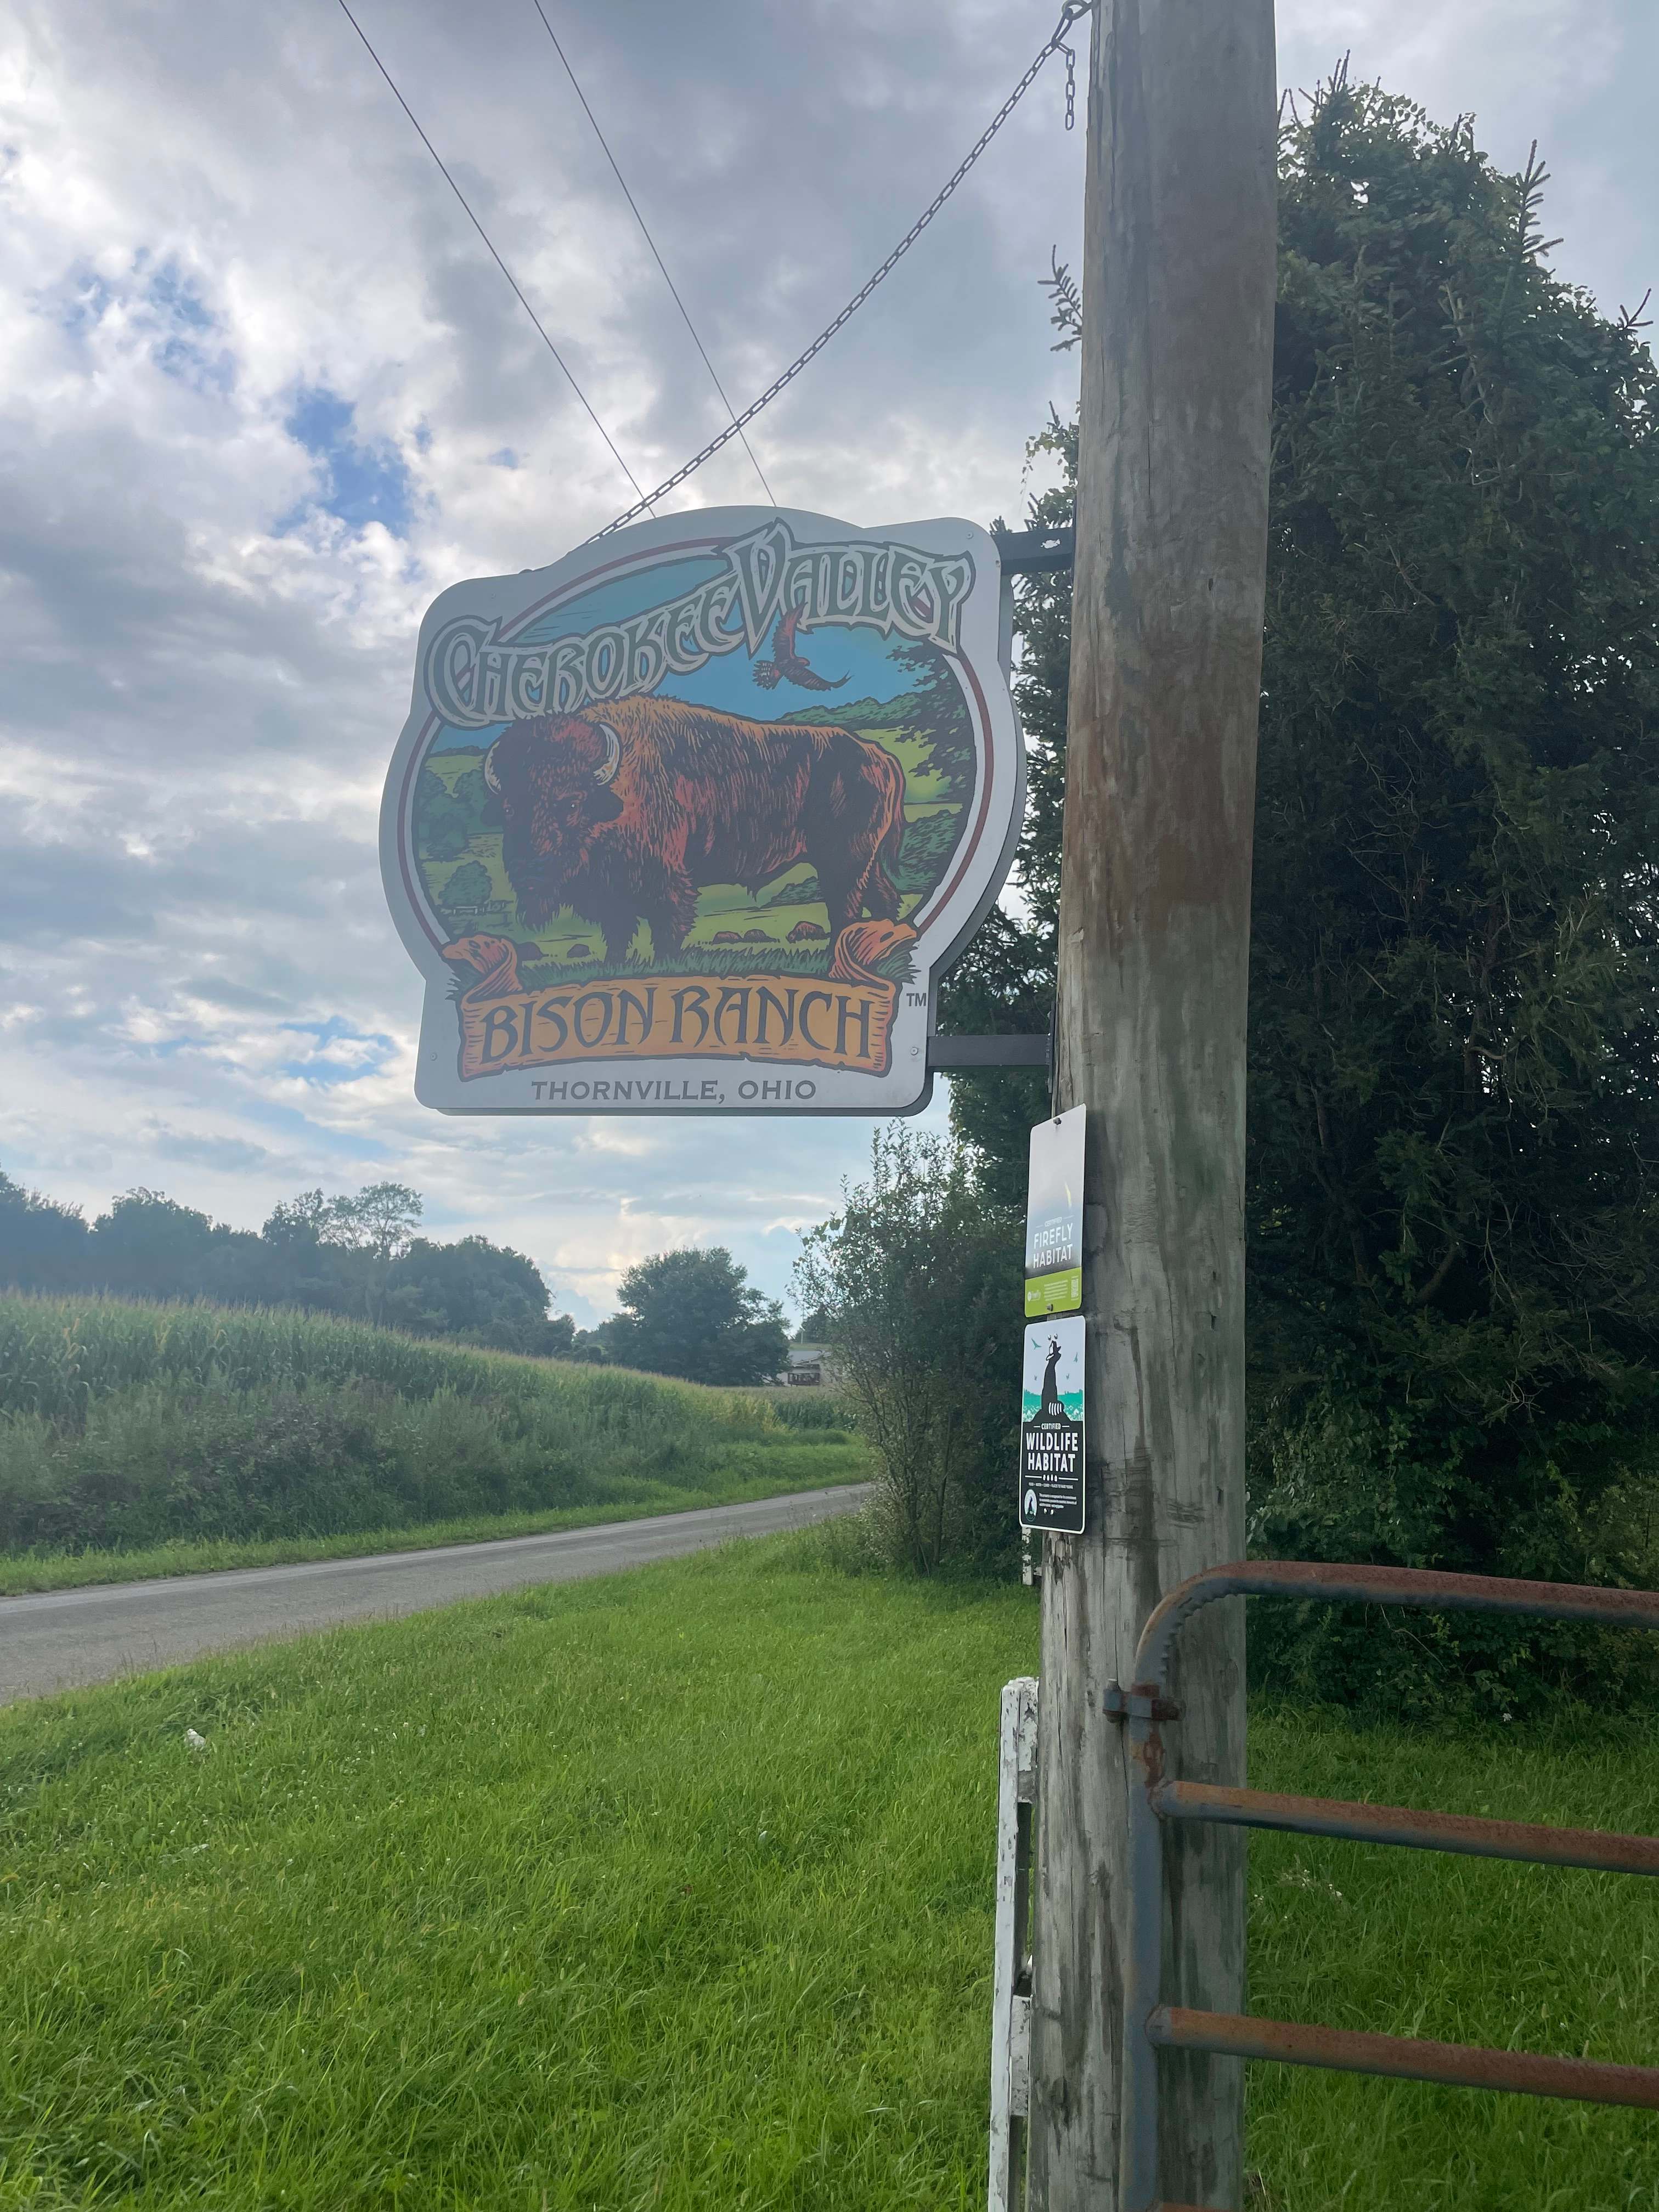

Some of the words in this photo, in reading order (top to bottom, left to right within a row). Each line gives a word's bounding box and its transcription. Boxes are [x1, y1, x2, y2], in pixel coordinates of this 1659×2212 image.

[427, 572, 746, 727] CHEROKEE
[722, 522, 973, 654] VALLEY
[906, 992, 927, 1007] TM
[479, 987, 658, 1064] BISON
[670, 985, 874, 1059] RANCH
[531, 1080, 726, 1104] THORNVILLE,
[738, 1080, 816, 1099] OHIO
[1034, 1222, 1073, 1249] FIREFLY
[1033, 1243, 1073, 1269] HABITAT
[1026, 1432, 1078, 1451] WILDLIFE
[1028, 1452, 1076, 1472] HABITAT
